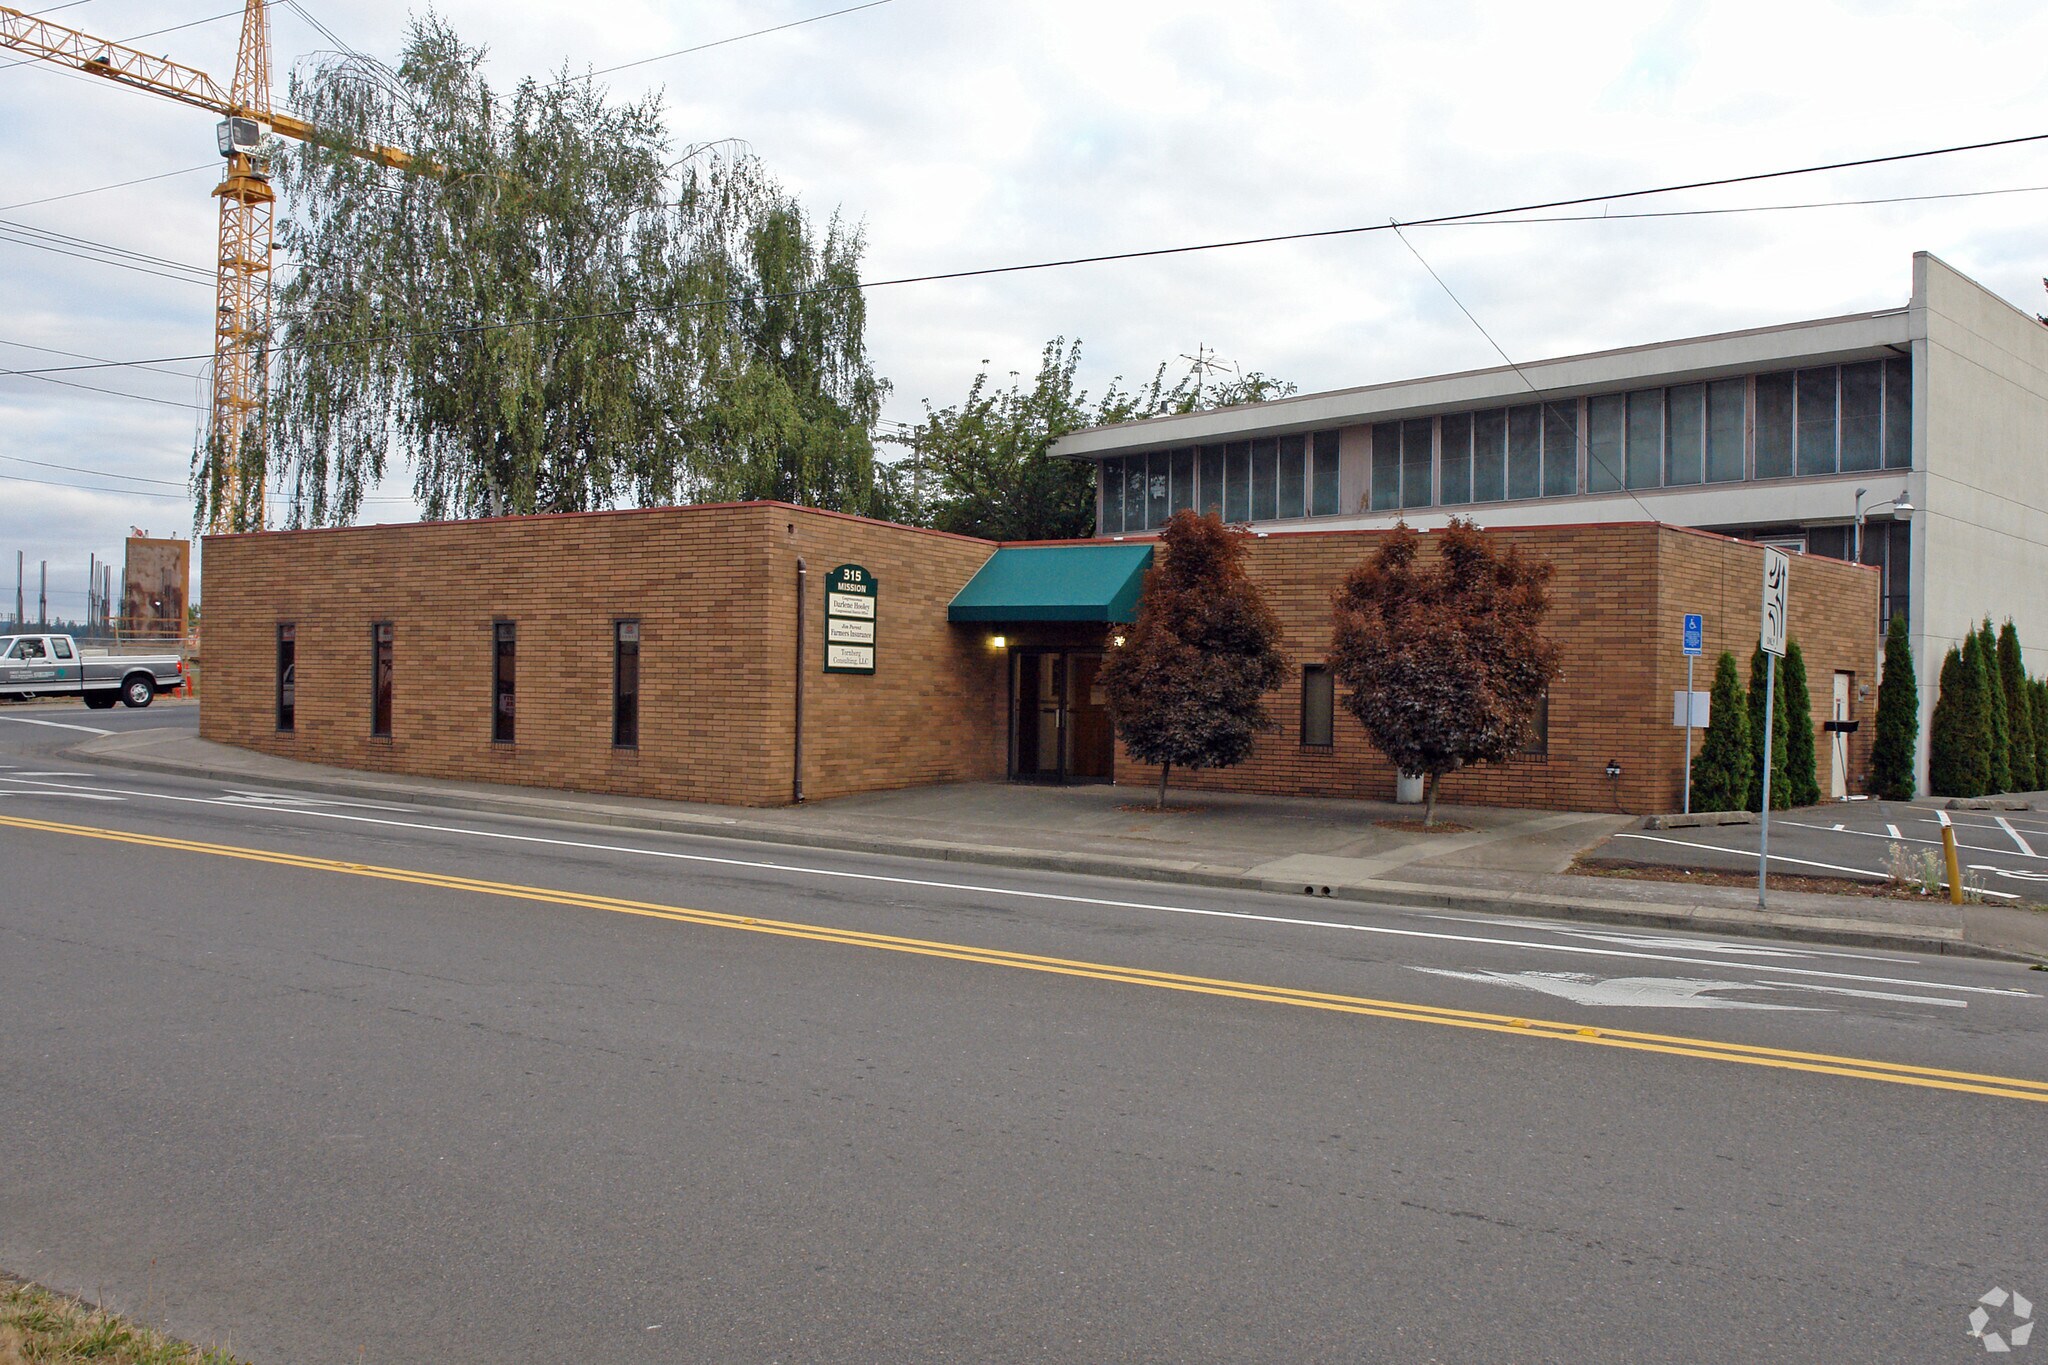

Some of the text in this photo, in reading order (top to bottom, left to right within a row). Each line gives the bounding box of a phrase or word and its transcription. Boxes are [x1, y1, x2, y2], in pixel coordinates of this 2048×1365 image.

[843, 569, 861, 581] 315
[837, 582, 867, 593] MISSION
[833, 600, 853, 609] Darlene
[830, 628, 871, 639] Farmers Insurance
